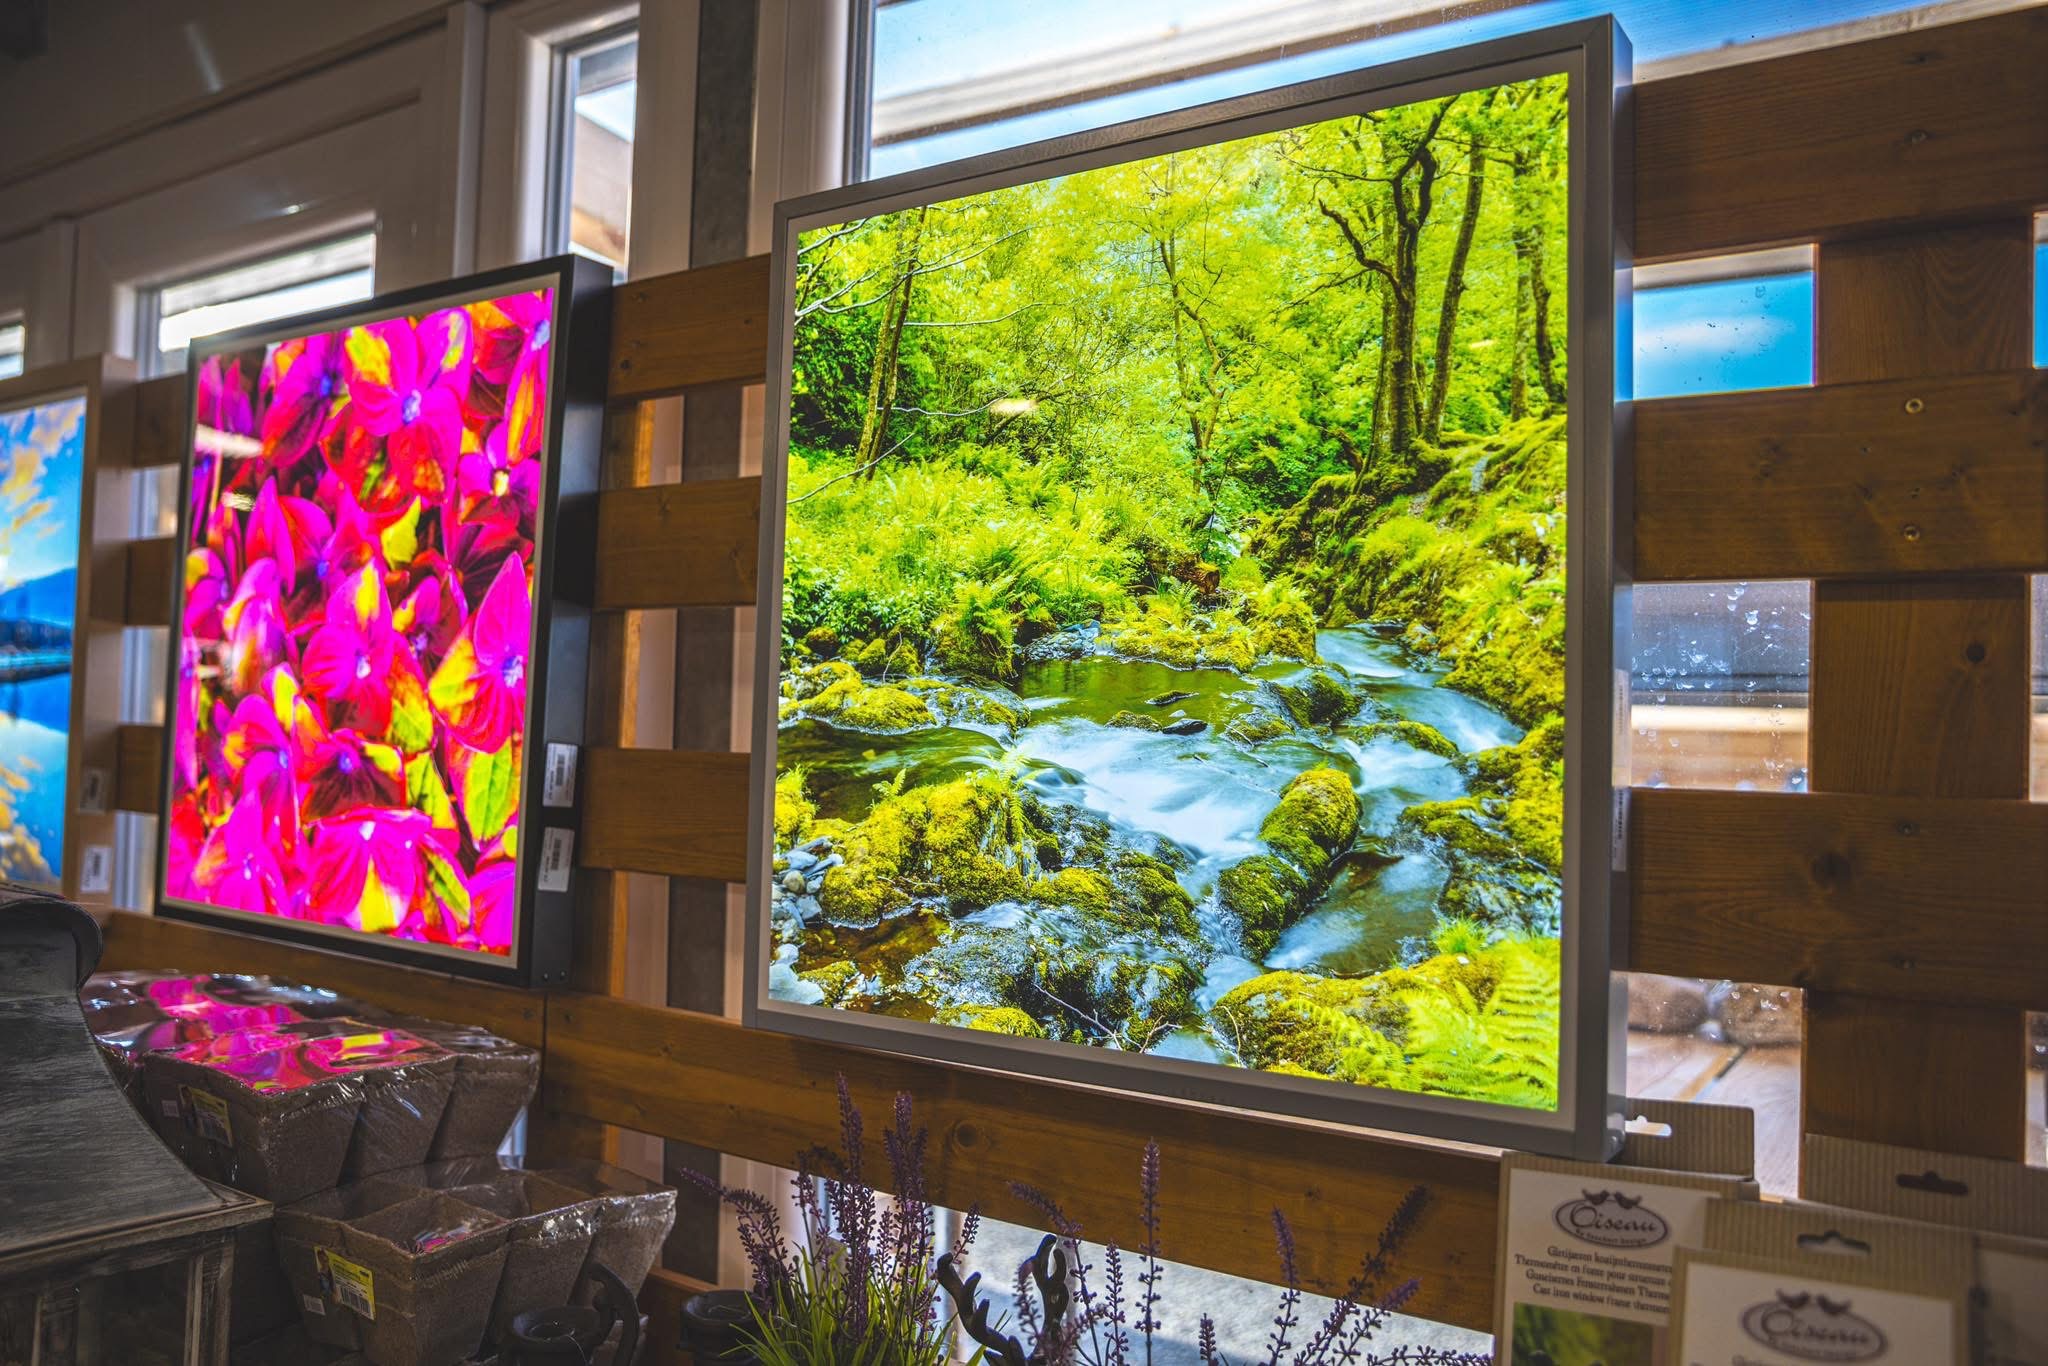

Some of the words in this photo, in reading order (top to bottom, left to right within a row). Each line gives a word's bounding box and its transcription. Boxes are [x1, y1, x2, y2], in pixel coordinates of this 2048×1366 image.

[1570, 1203, 1657, 1232] Oiseau
[1532, 1283, 1551, 1295] Cast
[1572, 1290, 1604, 1303] window
